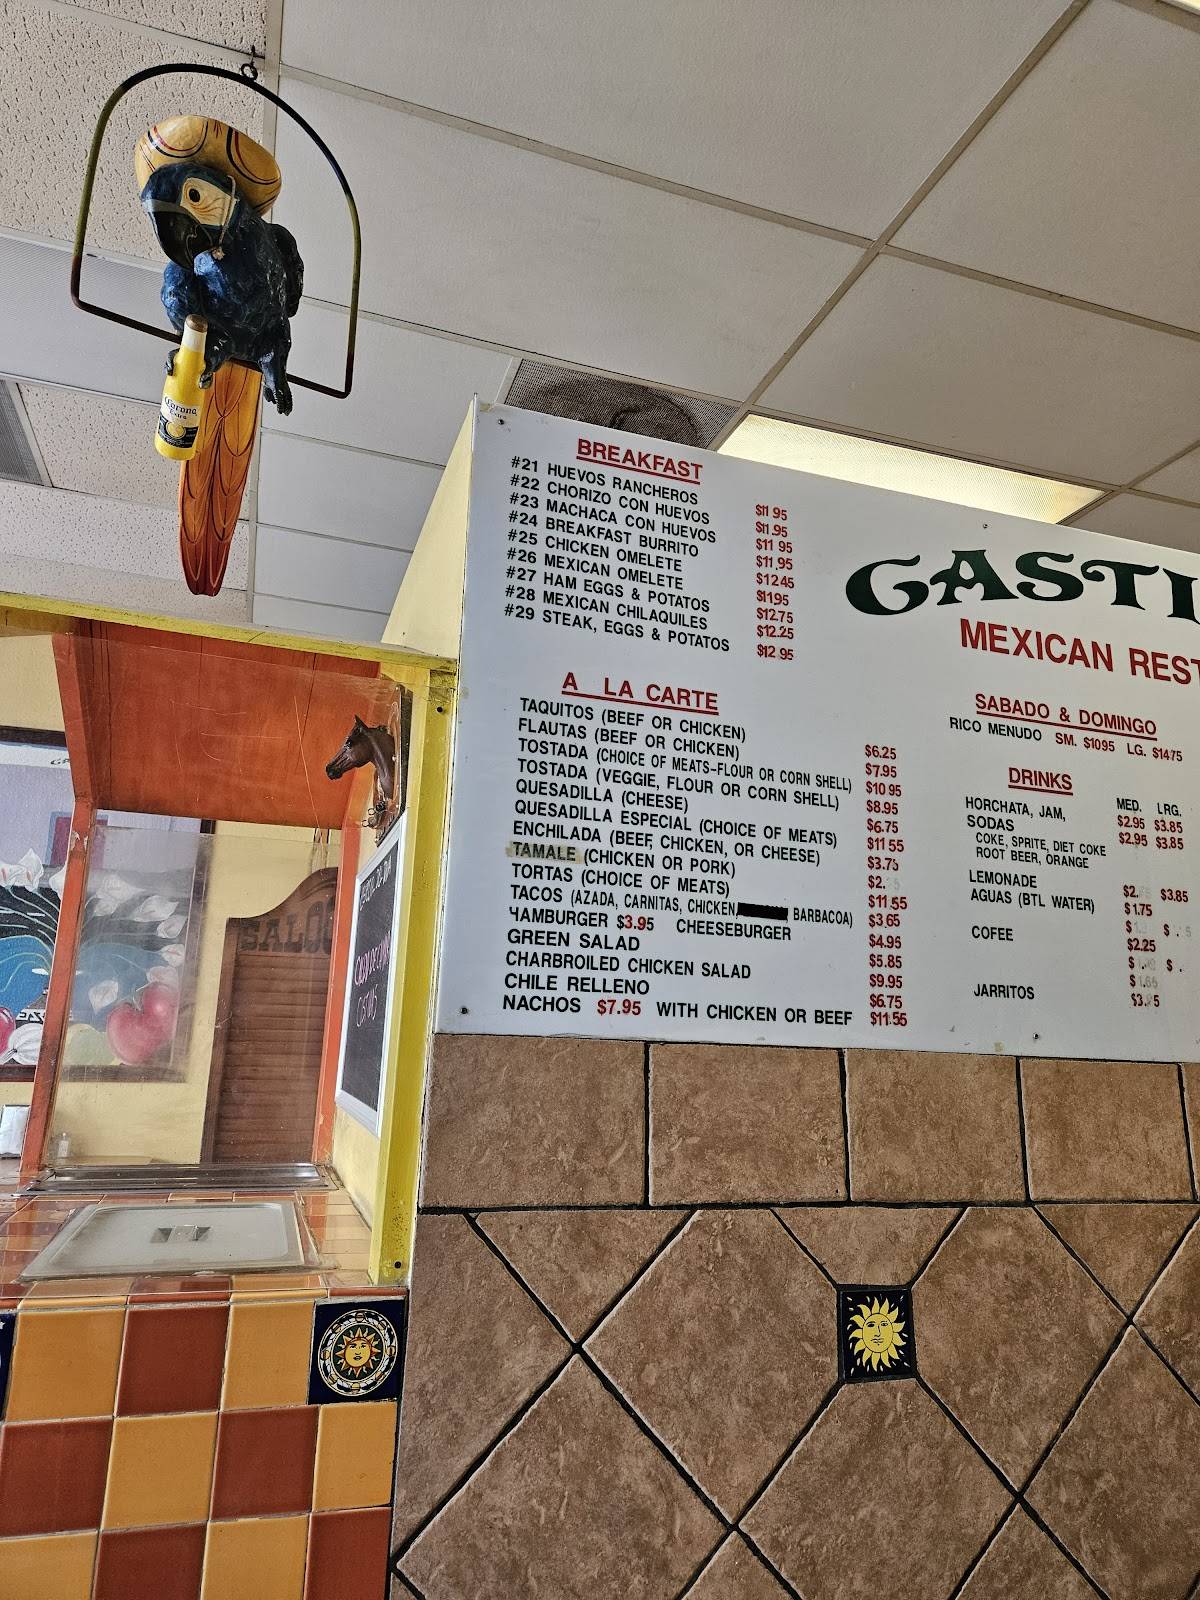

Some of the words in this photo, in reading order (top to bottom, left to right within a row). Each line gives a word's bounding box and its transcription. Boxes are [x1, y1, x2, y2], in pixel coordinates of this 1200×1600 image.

[578, 438, 703, 479] BREAKFAST
[511, 456, 538, 472] #21
[548, 463, 605, 486] HUEVOS
[612, 476, 698, 505] RANCHEROS
[510, 474, 539, 491] #22
[548, 481, 611, 505] CHORIZO
[619, 496, 648, 513] CON
[656, 502, 709, 524] HUEVOS
[510, 492, 538, 509] #23
[546, 499, 618, 524] MACHACA
[625, 514, 655, 532] CON
[662, 522, 716, 543] HUEVOS
[755, 521, 788, 538] $11.95
[508, 510, 538, 527] #24
[546, 516, 632, 544] BREAKFAST
[639, 535, 698, 557] BURRITO
[508, 529, 538, 545] #25
[546, 536, 609, 558] CHICKEN
[616, 548, 682, 572] OMELETE
[756, 555, 793, 571] $11.95
[507, 547, 536, 564] #26
[544, 553, 610, 577] MEXICAN
[618, 567, 683, 590] OMELETE
[506, 566, 536, 582] #27
[544, 572, 576, 590] HAM
[584, 579, 624, 598] EGGS
[631, 588, 640, 601] &
[648, 590, 710, 612] POTATOS
[505, 584, 535, 601] #28
[543, 590, 609, 614] MEXICAN
[617, 603, 707, 630] CHILAQUILES
[504, 603, 534, 620] #29
[542, 610, 596, 633] STEAK,
[604, 620, 644, 638] EGGS
[652, 628, 660, 641] &
[668, 630, 729, 651] POTATOS
[756, 625, 794, 640] $12.25
[960, 618, 1113, 672] MEXICAN
[562, 672, 578, 690] A
[604, 677, 634, 698] LA
[646, 684, 718, 710] CARTE
[520, 697, 594, 720] TAQUITOS
[602, 709, 644, 726] (BEEF
[652, 716, 672, 730] OR
[680, 720, 745, 743] CHICKEN)
[976, 694, 1050, 719] SABADO
[1060, 707, 1070, 722] &
[1079, 709, 1156, 735] DOMINGO
[519, 718, 586, 739] FLAUTAS
[594, 728, 637, 745] (BEEF
[645, 734, 665, 750] OR
[673, 738, 739, 762] CHICKEN)
[950, 716, 982, 732] RICO
[988, 722, 1042, 741] MENUDO
[1055, 732, 1077, 746] SM.
[1127, 743, 1146, 756] LG.
[865, 744, 897, 760] $6.25
[518, 738, 588, 760] TOSTADA
[596, 748, 645, 766] (CHOICE
[651, 754, 666, 768] OF
[672, 757, 753, 780] MEATS-FLOUR
[759, 768, 774, 782] OR
[780, 770, 810, 786] CORN
[816, 774, 851, 794] SHELL)
[865, 763, 897, 778] $7.95
[1009, 767, 1072, 790] DRINKS
[516, 778, 613, 802] QUESADILLA
[622, 790, 688, 814] (CHEESE)
[518, 758, 588, 780] TOSTADA
[596, 768, 659, 791] (VEGGIE,
[667, 776, 713, 794] FLOUR
[721, 782, 740, 798] OR
[748, 785, 786, 802] CORN
[793, 790, 839, 812] SHELL)
[866, 800, 898, 815] $8.95
[966, 796, 1033, 818] HORCHATA,
[1039, 805, 1065, 822] JAM,
[1116, 798, 1142, 812] MED.
[1157, 802, 1182, 817] LRG.
[515, 800, 612, 823] QUESADILLA
[620, 810, 692, 832] ESPECIAL
[700, 819, 756, 838] (CHOICE
[764, 826, 781, 840] OF
[789, 828, 837, 849] MEATS)
[867, 818, 898, 834] $6.75
[967, 814, 1014, 832] SODAS
[1117, 815, 1145, 830] $2.95
[1154, 819, 1183, 834] $3.85
[514, 820, 602, 843] ENCHILADA
[610, 830, 653, 850] (BEEF,
[660, 835, 727, 858] CHICKEN,
[734, 842, 754, 857] OR
[762, 845, 820, 867] CHEESE)
[976, 832, 1008, 848] COKE,
[1012, 836, 1049, 853] SPRITE,
[1054, 841, 1074, 852] DIET
[1080, 843, 1106, 856] COKE
[1119, 831, 1148, 847] $2.95
[1155, 836, 1184, 850] $3.85
[513, 842, 576, 862] TAMALE
[584, 848, 654, 868] (CHICKEN
[662, 855, 682, 871] OR
[690, 858, 735, 879] PORK)
[976, 847, 1005, 860] ROOT
[1011, 850, 1041, 865] BEER,
[1046, 854, 1089, 868] ORANGE
[512, 863, 573, 882] TORTAS
[581, 869, 642, 888] (CHOICE
[650, 875, 670, 890] OF
[678, 877, 729, 899] MEATS)
[970, 870, 1037, 888] LEMONADE
[510, 884, 562, 902] TACOS
[571, 889, 618, 910] (AZADA,
[624, 894, 682, 915] CARNITAS,
[794, 907, 852, 928] BARBACOA)
[971, 888, 1012, 904] AGUAS
[1018, 892, 1046, 908] (BTL
[1051, 895, 1094, 914] WATER)
[1160, 888, 1189, 903] $3.85
[508, 928, 570, 947] GREEN
[580, 933, 640, 951] SALAD
[616, 914, 654, 931] $3.95
[676, 919, 791, 940] CHEESEBURGER
[972, 926, 1013, 941] COFEE
[1127, 937, 1156, 952] $2.25
[506, 950, 620, 972] CHARBROILED
[628, 958, 694, 976] CHICKEN
[702, 962, 751, 979] SALAD
[869, 953, 902, 968] $5.85
[505, 973, 558, 990] CHILE
[568, 976, 649, 995] RELLENO
[869, 974, 903, 988] $9.95
[974, 984, 1034, 1000] JARRITOS
[503, 994, 581, 1013] NACHOS
[597, 998, 641, 1016] $7.95
[656, 1002, 698, 1018] WITH
[706, 1004, 776, 1021] CHICKEN
[784, 1008, 806, 1023] OR
[814, 1010, 852, 1025] BEEF
[870, 993, 903, 1009] $6.75
